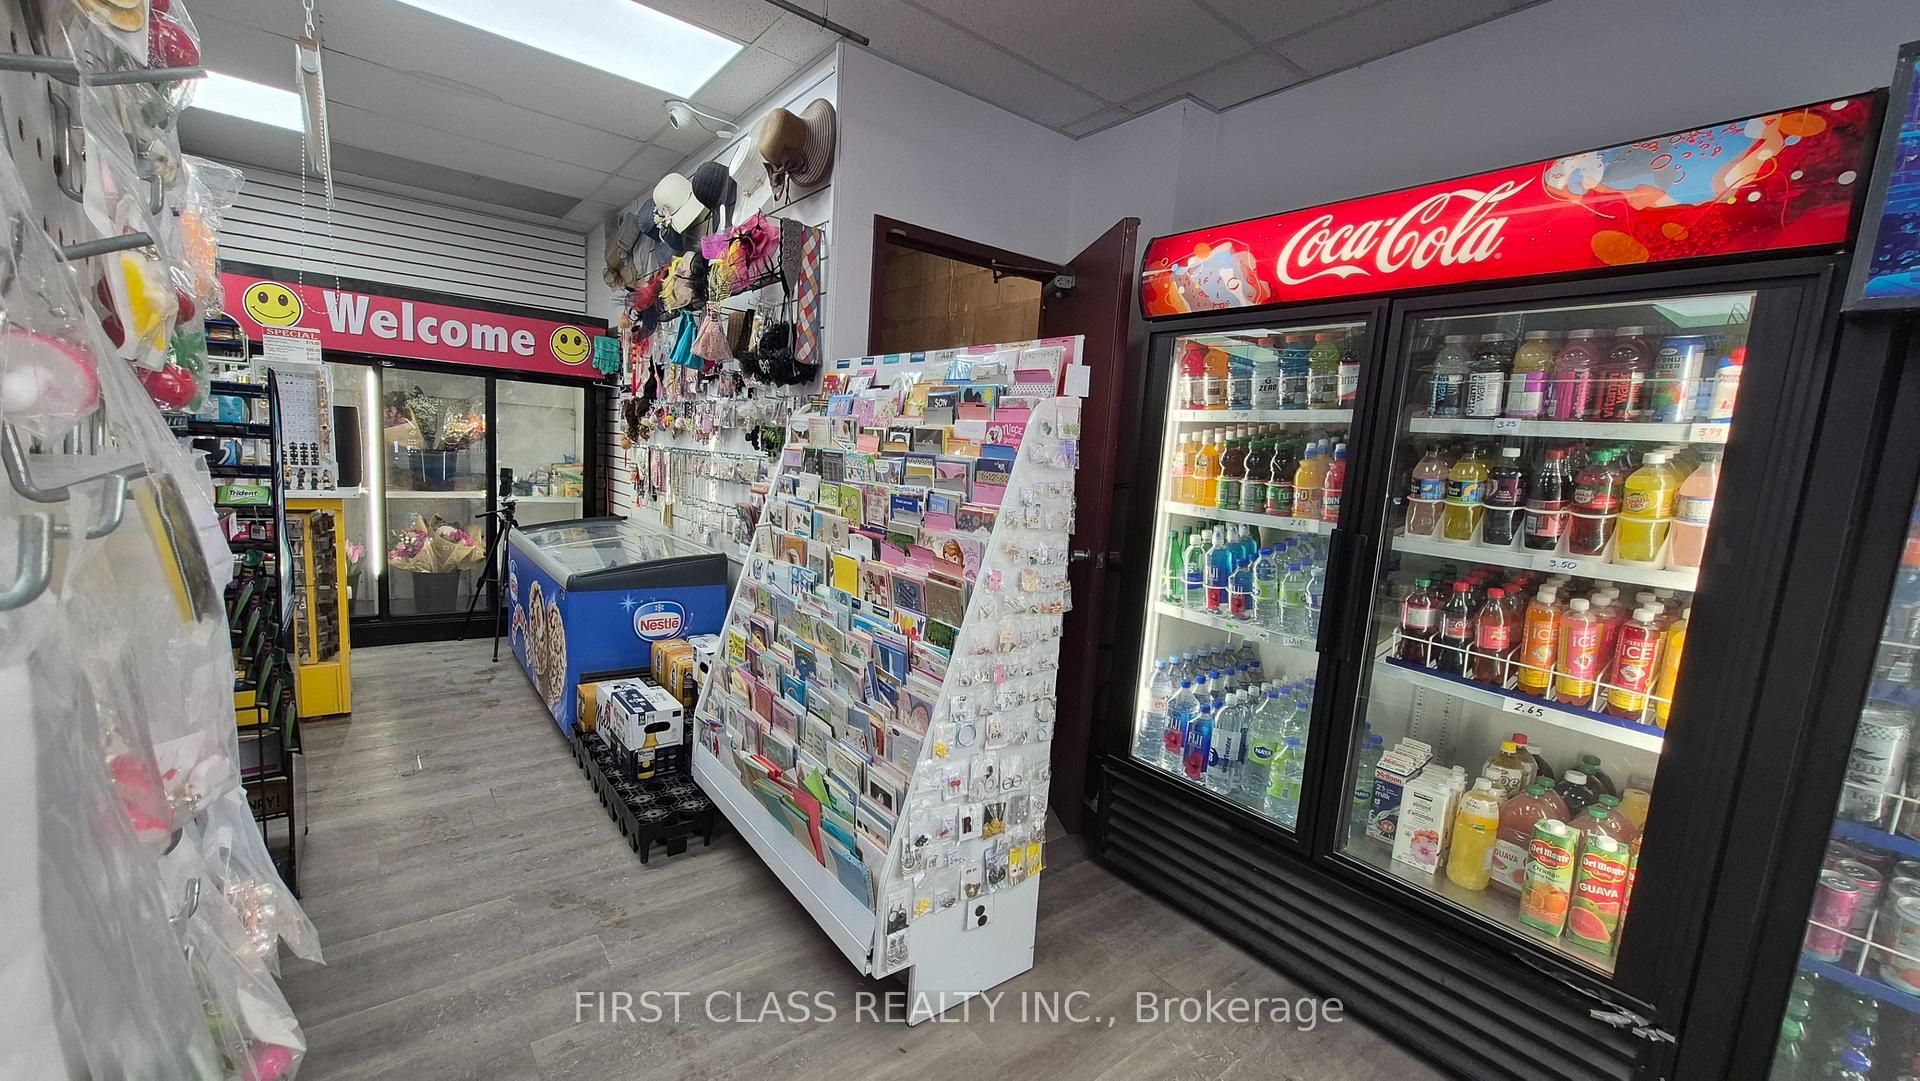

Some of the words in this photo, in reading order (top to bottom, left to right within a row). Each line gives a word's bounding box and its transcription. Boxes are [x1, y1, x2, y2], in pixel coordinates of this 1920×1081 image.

[1277, 176, 1536, 285] Coca-Cola
[322, 290, 535, 357] Welcome
[266, 328, 318, 340] SPECIAL
[934, 399, 948, 408] SON
[229, 489, 258, 497] Trident
[1549, 560, 1577, 570] 3.50
[1533, 629, 1557, 641] ICE
[1572, 635, 1597, 648] ICE
[1622, 646, 1653, 660] ICE
[1515, 702, 1544, 717] 2.65
[1188, 732, 1203, 747] FIJI
[1255, 747, 1272, 758] NAYA
[1375, 791, 1391, 801] milk
[1494, 849, 1519, 863] GUAVA
[1530, 843, 1544, 854] Del
[1544, 847, 1570, 863] Monte
[1583, 857, 1597, 868] Del
[1597, 861, 1626, 877] Monte
[1579, 882, 1619, 898] GUAVA
